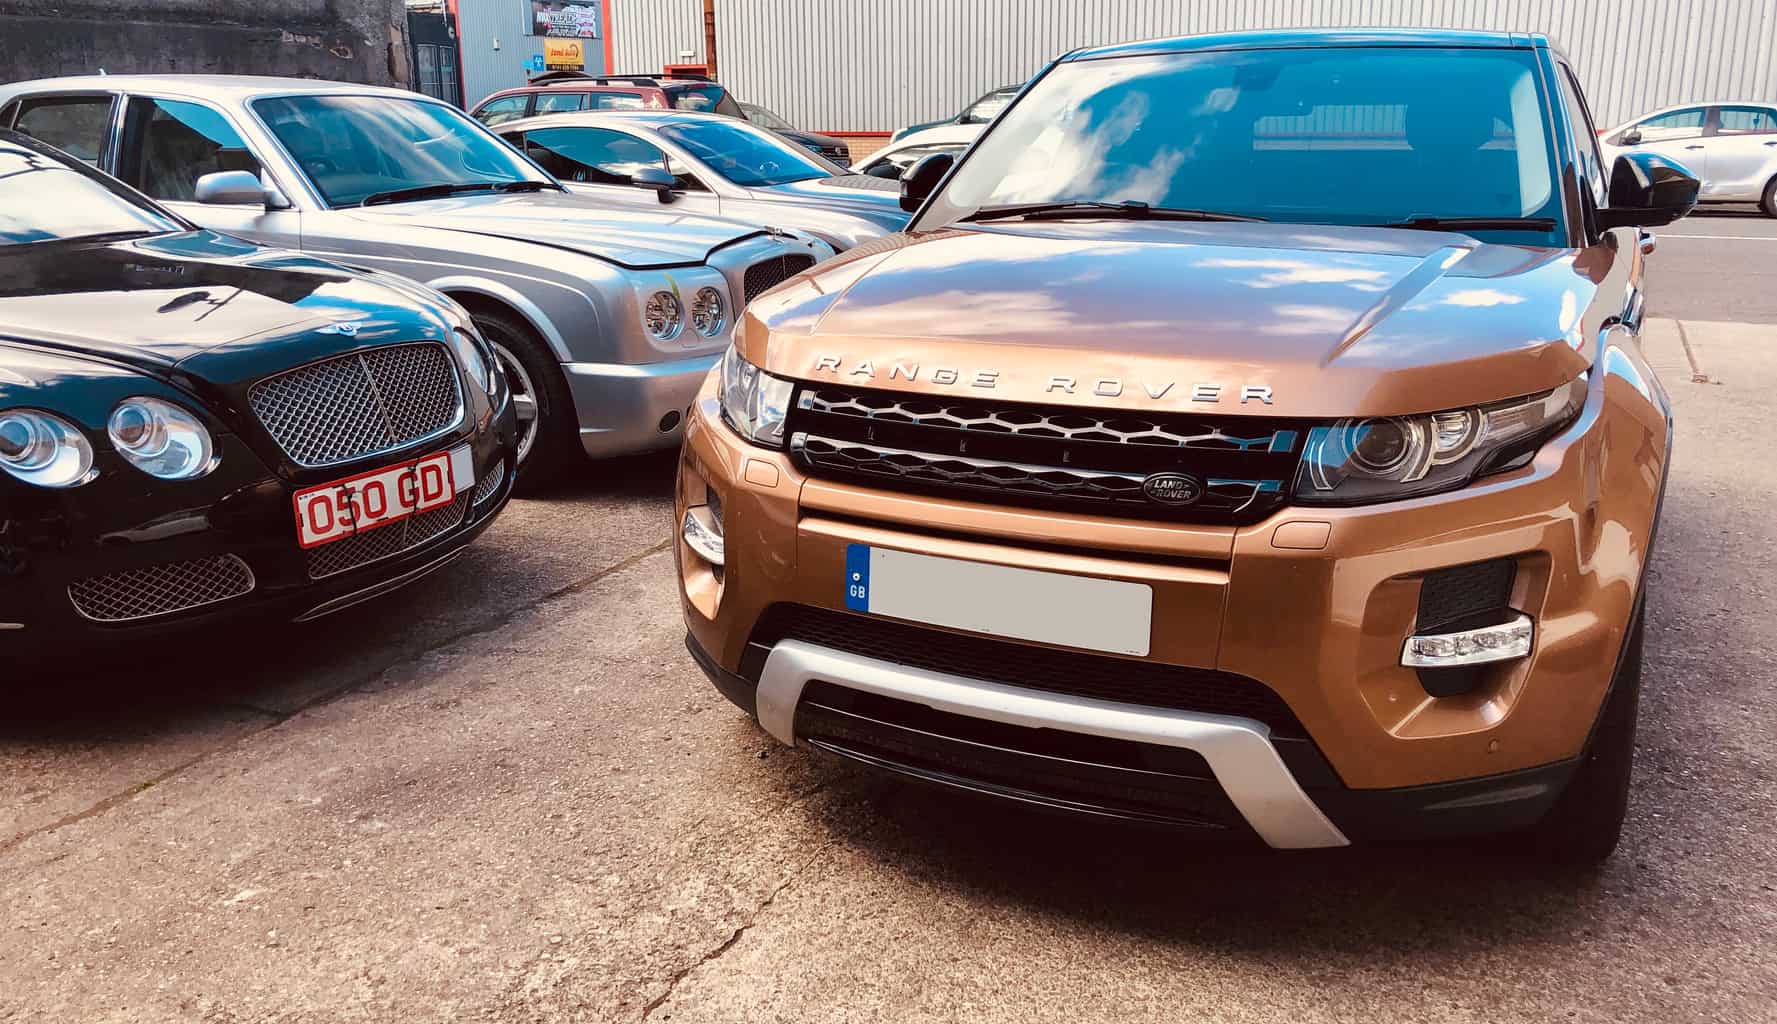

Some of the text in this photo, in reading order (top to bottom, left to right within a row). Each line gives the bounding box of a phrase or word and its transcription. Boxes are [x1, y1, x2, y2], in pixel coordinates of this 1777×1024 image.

[815, 355, 1273, 405] RANGE ROVER
[397, 464, 444, 509] GD
[1154, 479, 1184, 490] LAND
[1155, 488, 1192, 499] ROVER
[850, 584, 866, 599] GB
